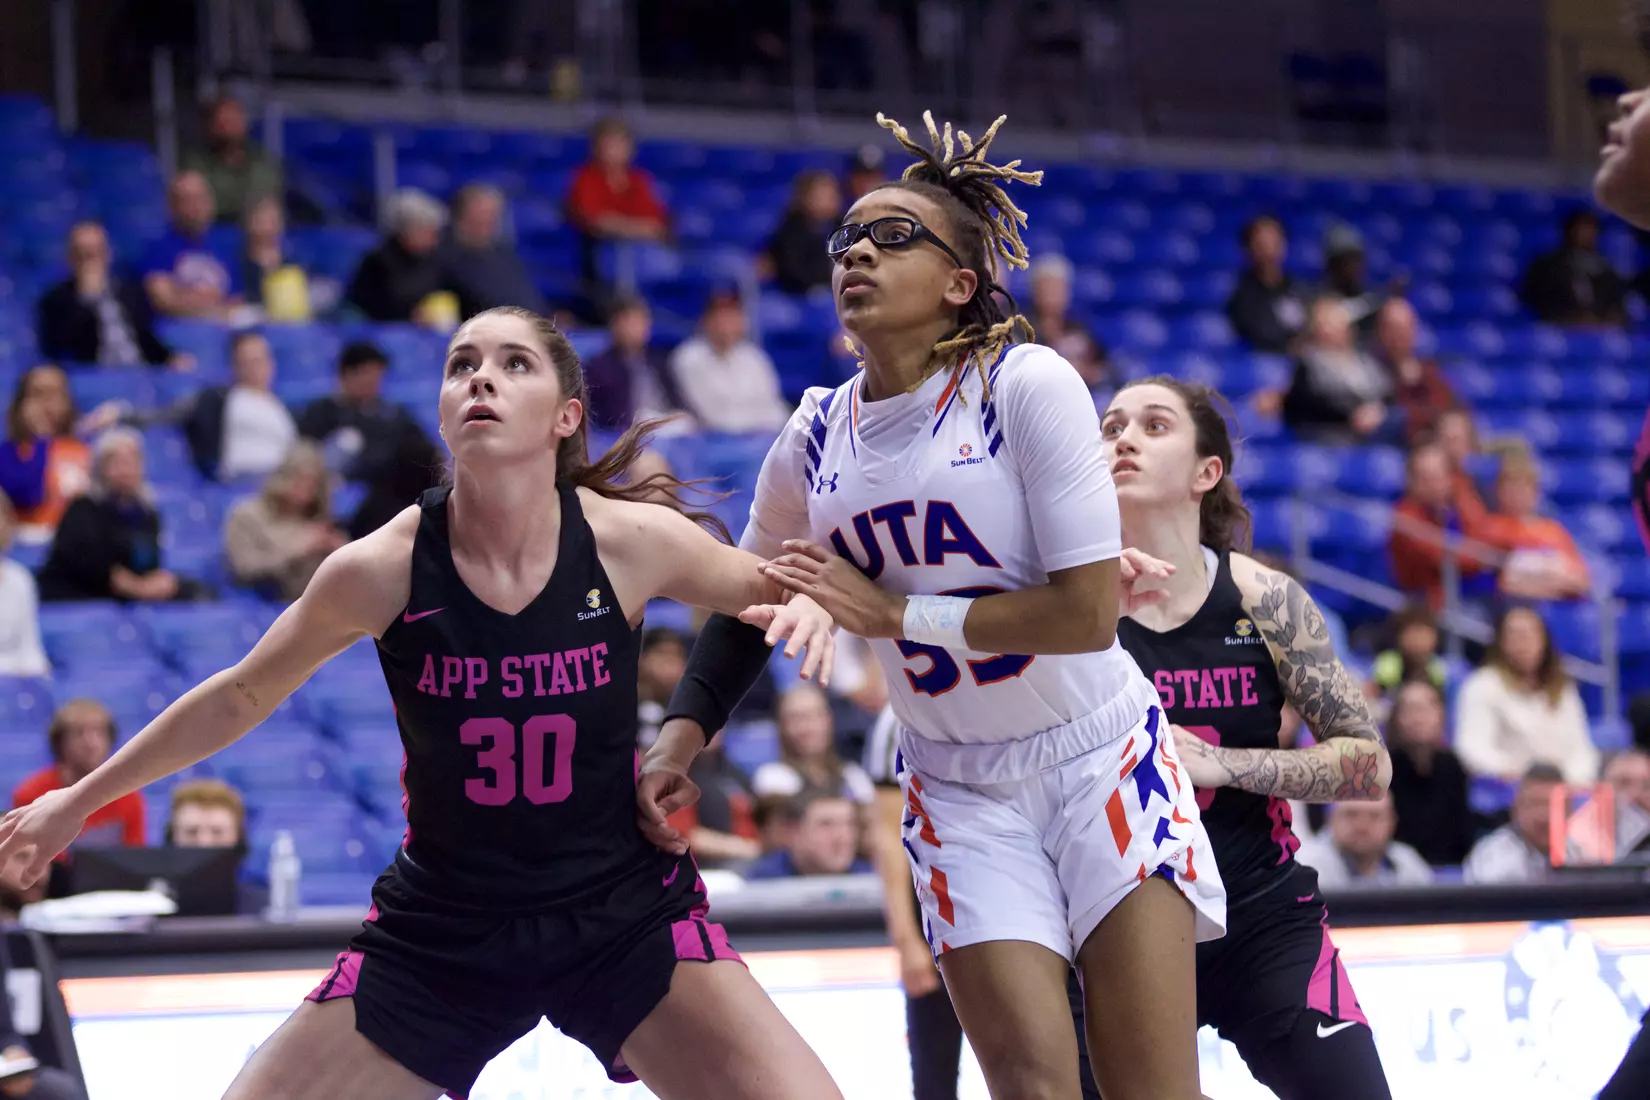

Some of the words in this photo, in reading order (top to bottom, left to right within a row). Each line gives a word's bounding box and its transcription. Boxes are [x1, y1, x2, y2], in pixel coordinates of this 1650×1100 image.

[950, 460, 966, 468] SUN
[966, 457, 983, 465] BELT
[829, 500, 1004, 581] UTA
[1224, 636, 1243, 645] SUN
[416, 653, 489, 699] APP
[501, 642, 612, 698] STATE
[1154, 666, 1259, 709] STATE
[459, 713, 577, 807] 30
